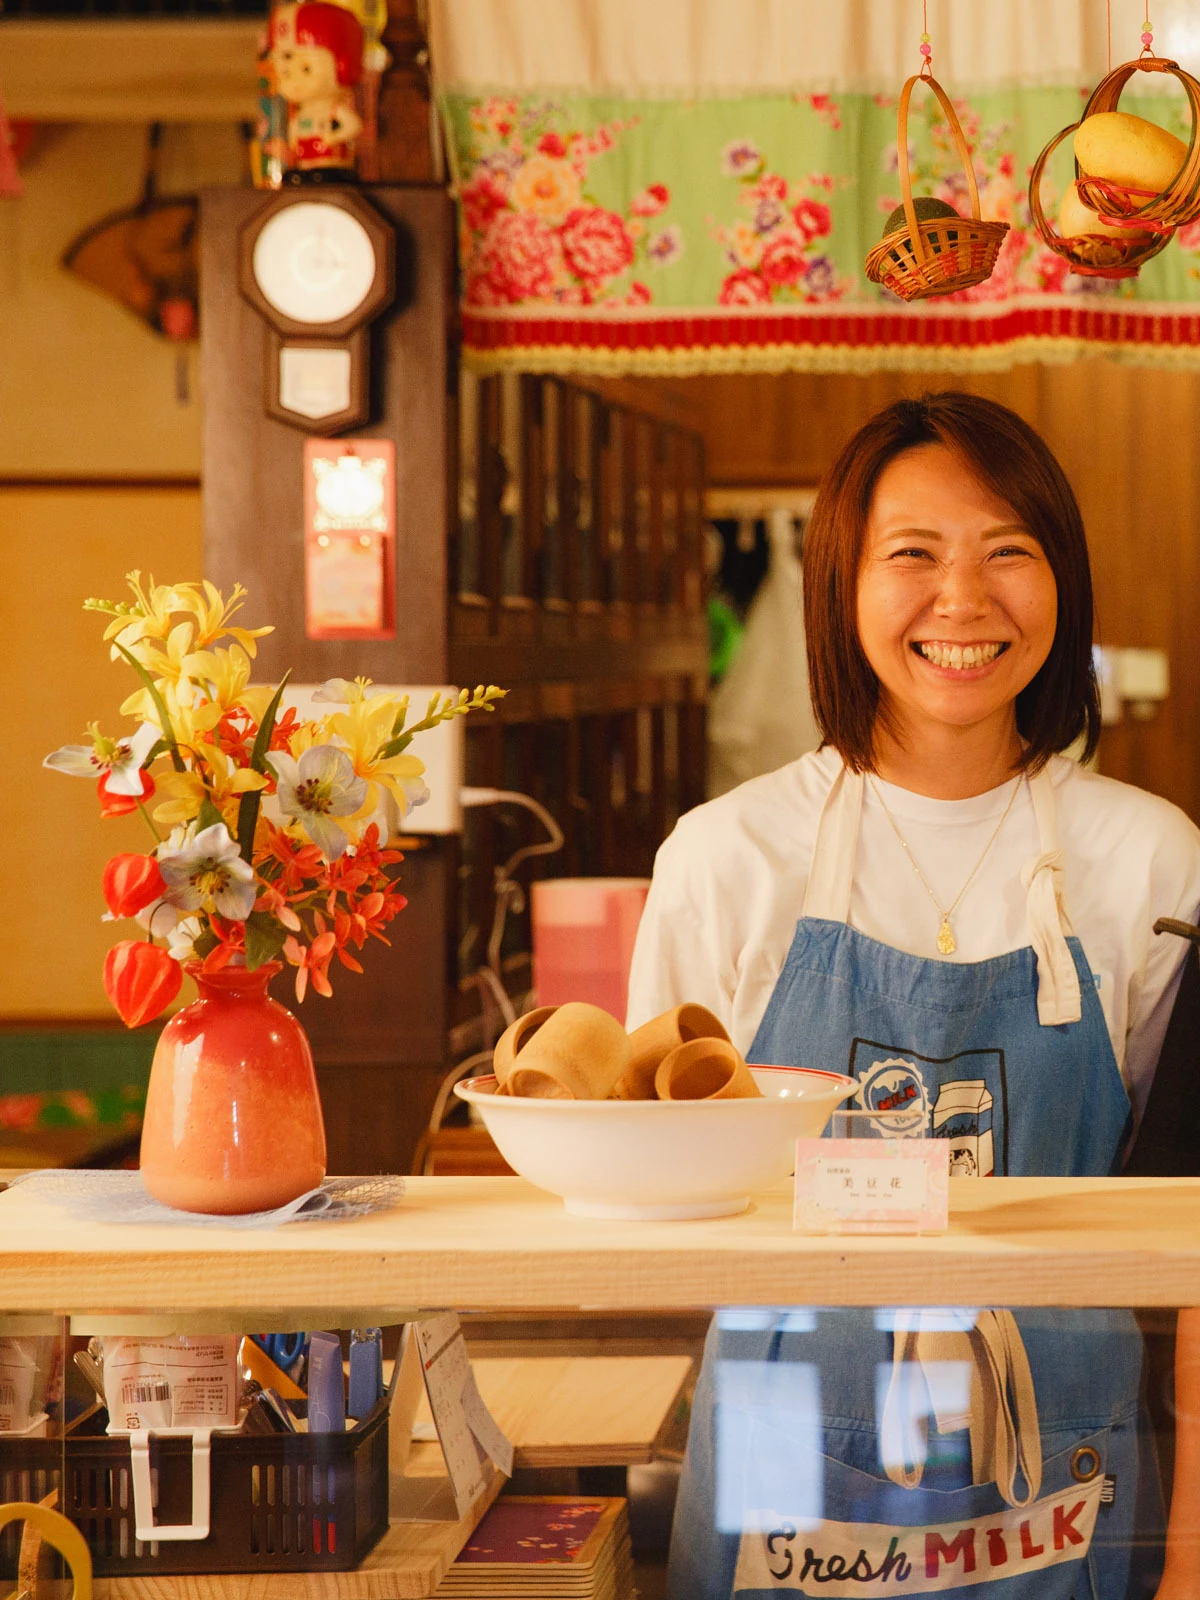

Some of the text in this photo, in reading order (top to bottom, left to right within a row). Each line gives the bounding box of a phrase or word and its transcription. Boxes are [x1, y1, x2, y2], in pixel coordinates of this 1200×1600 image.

[878, 1083, 917, 1111] MILK
[1100, 1480, 1115, 1503] AND
[767, 1500, 1087, 1582] Fresh MILK
